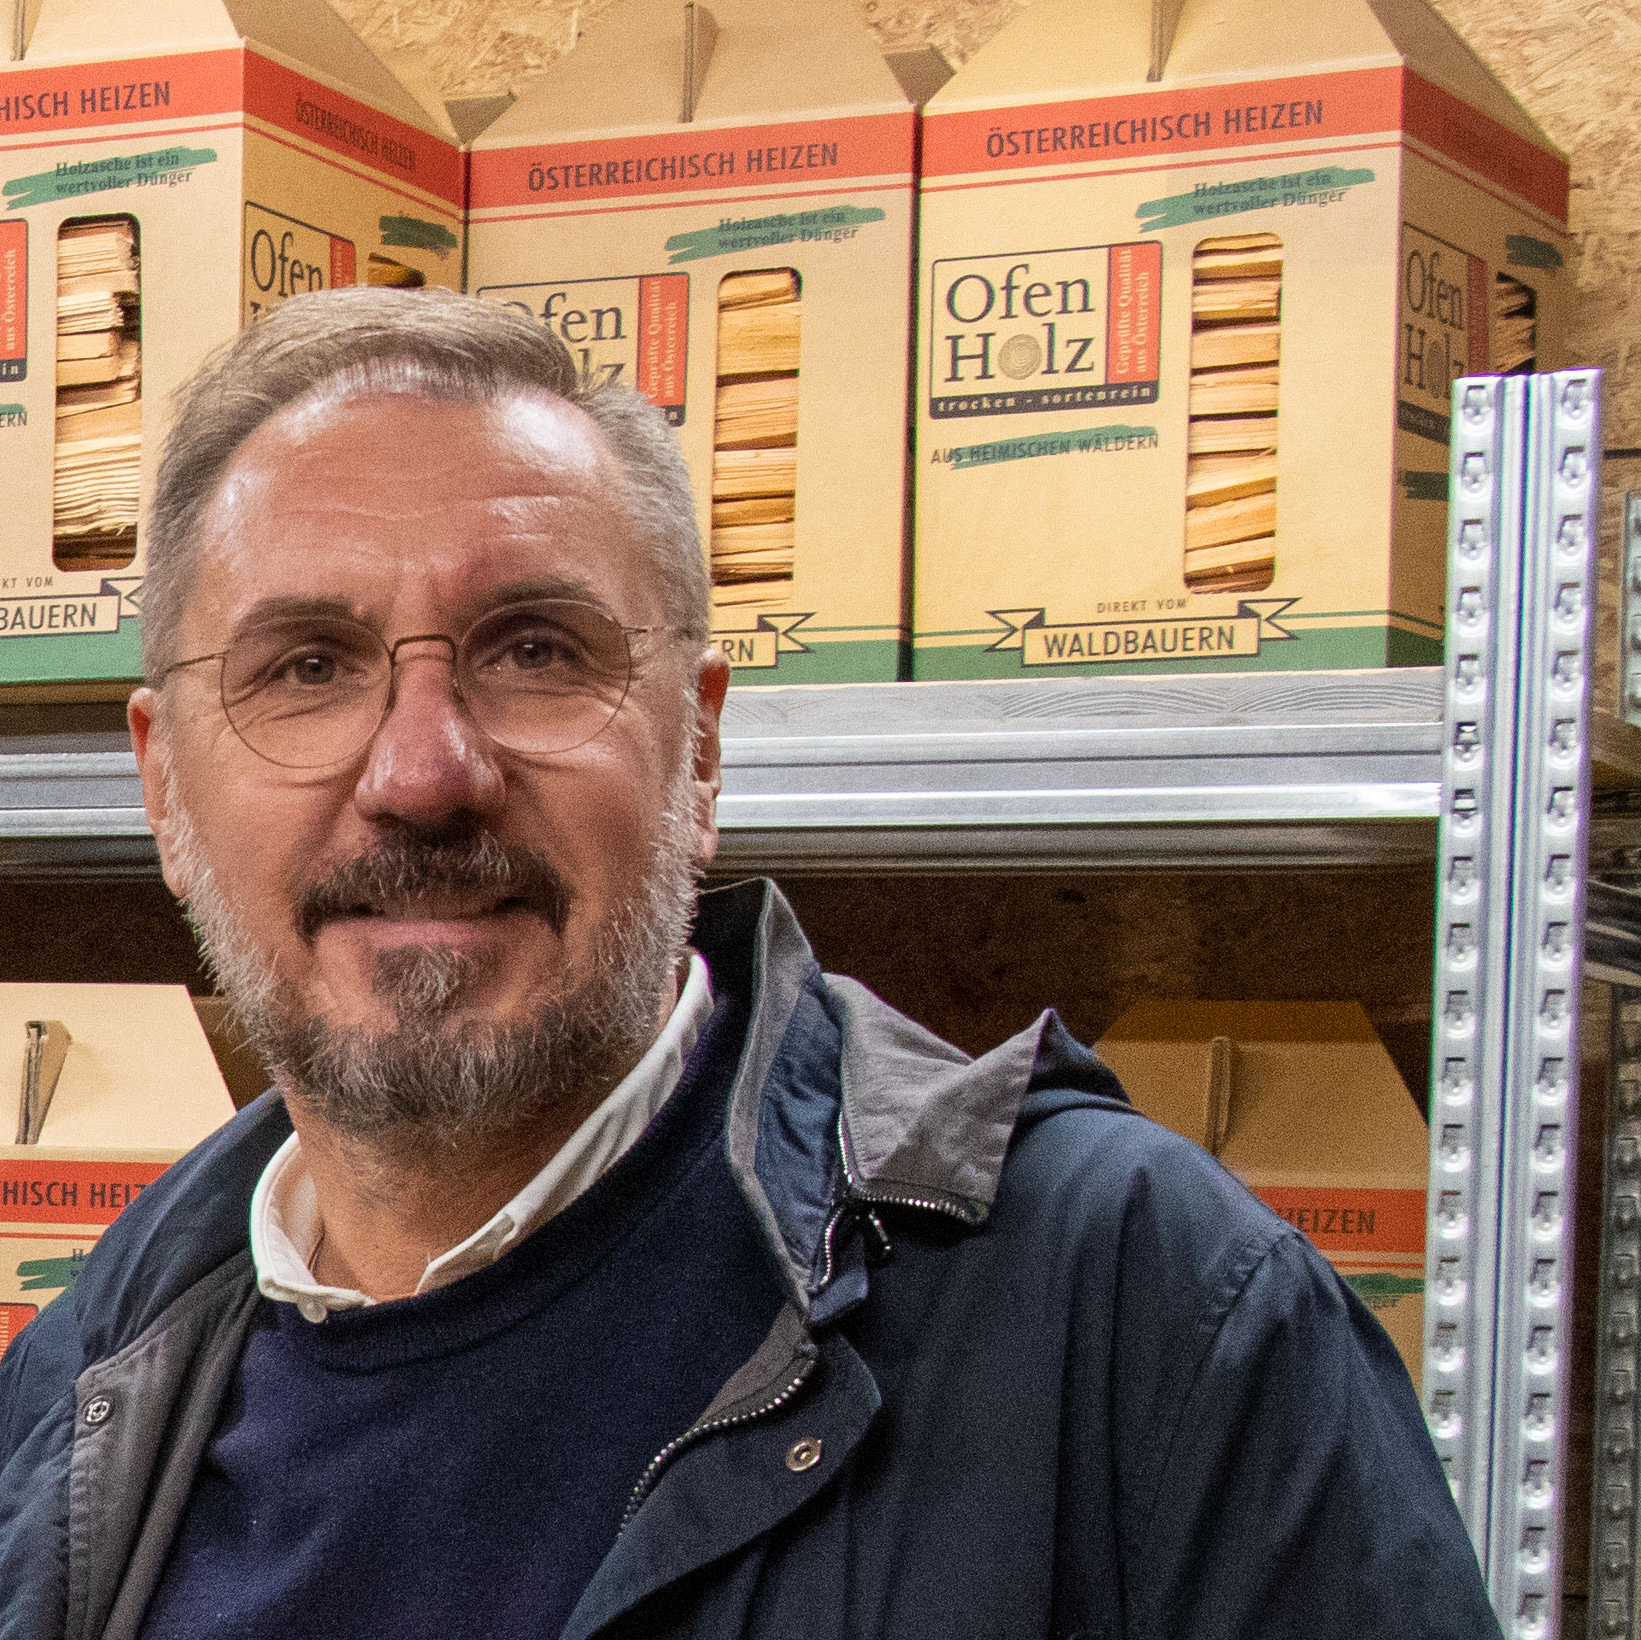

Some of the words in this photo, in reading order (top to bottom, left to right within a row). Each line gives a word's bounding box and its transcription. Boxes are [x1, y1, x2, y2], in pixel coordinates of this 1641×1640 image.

[80, 80, 171, 115] HEIZEN
[986, 111, 1211, 159] ÖSTERREICHISCH
[1223, 99, 1324, 136] HEIZEN
[55, 158, 132, 177] Holzasche
[135, 155, 154, 170] ist
[156, 152, 180, 168] ein
[55, 175, 135, 195] wertvoller
[137, 168, 193, 190] Dünger
[527, 151, 736, 192] ÖSTERREICHISCH
[747, 142, 840, 174] HEIZEN
[1192, 178, 1276, 198] Holzasche
[1279, 175, 1301, 190] ist
[1305, 172, 1332, 187] ein
[1192, 196, 1278, 216] wertvoller
[1281, 188, 1347, 210] Dünger
[250, 229, 323, 297] Ofen
[1119, 247, 1133, 309] Qualität
[5, 248, 17, 325] Österreich
[945, 263, 1095, 323] Ofen
[1406, 248, 1464, 332] Ofen
[1136, 270, 1150, 347] Österreich
[5, 326, 17, 351] aus
[664, 301, 677, 375] Österreich
[944, 323, 1095, 382] Holz
[1117, 311, 1131, 376] Geprüfte
[1136, 348, 1148, 374] aus
[664, 375, 675, 398] aus
[937, 394, 1015, 414] trocken
[1041, 385, 1152, 406] sortenrein
[930, 447, 963, 465] AUS
[970, 438, 1071, 461] HEIMISCHEN
[1078, 432, 1159, 454] WÄLDERN
[26, 576, 55, 589] VOM
[1096, 600, 1146, 614] DIREKT
[1155, 598, 1187, 612] VOM
[1043, 626, 1236, 660] WALDBAUERN
